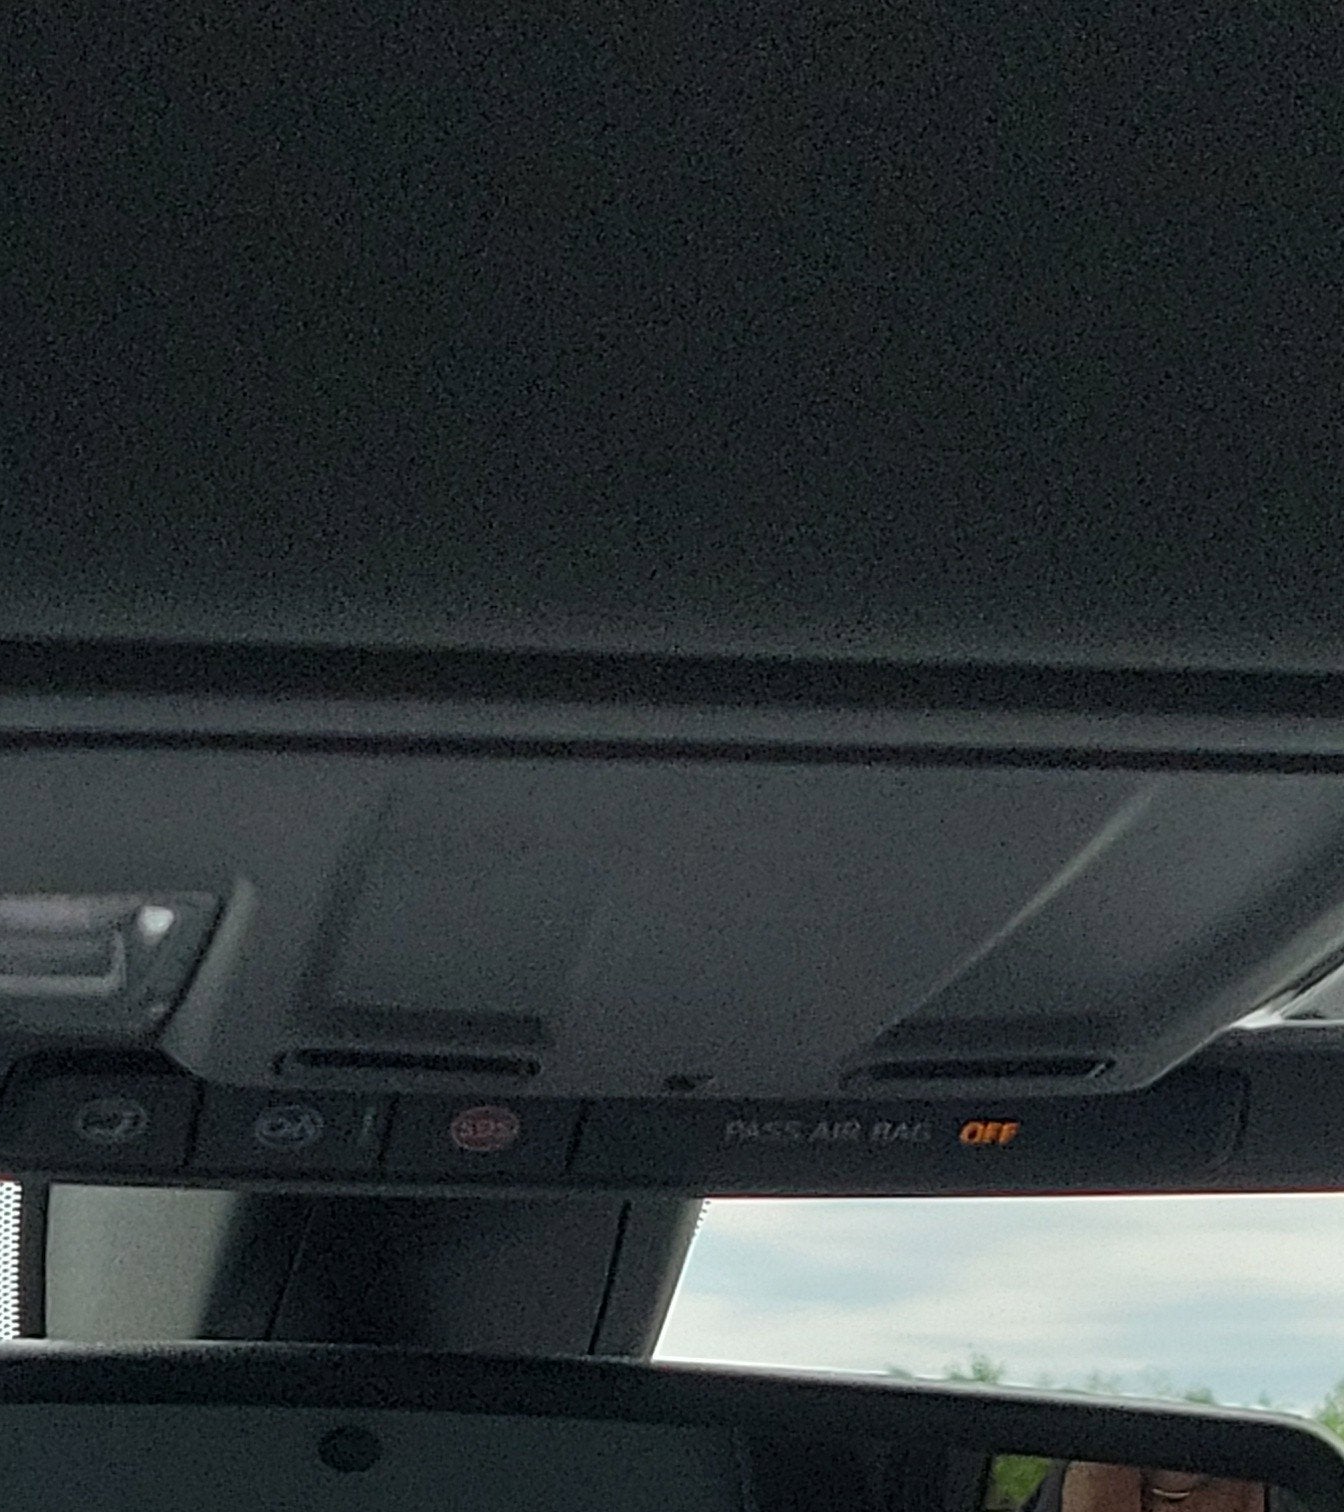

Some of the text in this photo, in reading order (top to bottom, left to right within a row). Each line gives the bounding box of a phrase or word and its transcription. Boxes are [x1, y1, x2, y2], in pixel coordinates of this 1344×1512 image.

[457, 1117, 511, 1139] SOS
[725, 1120, 1020, 1144] PASS AIR BAG OFF
